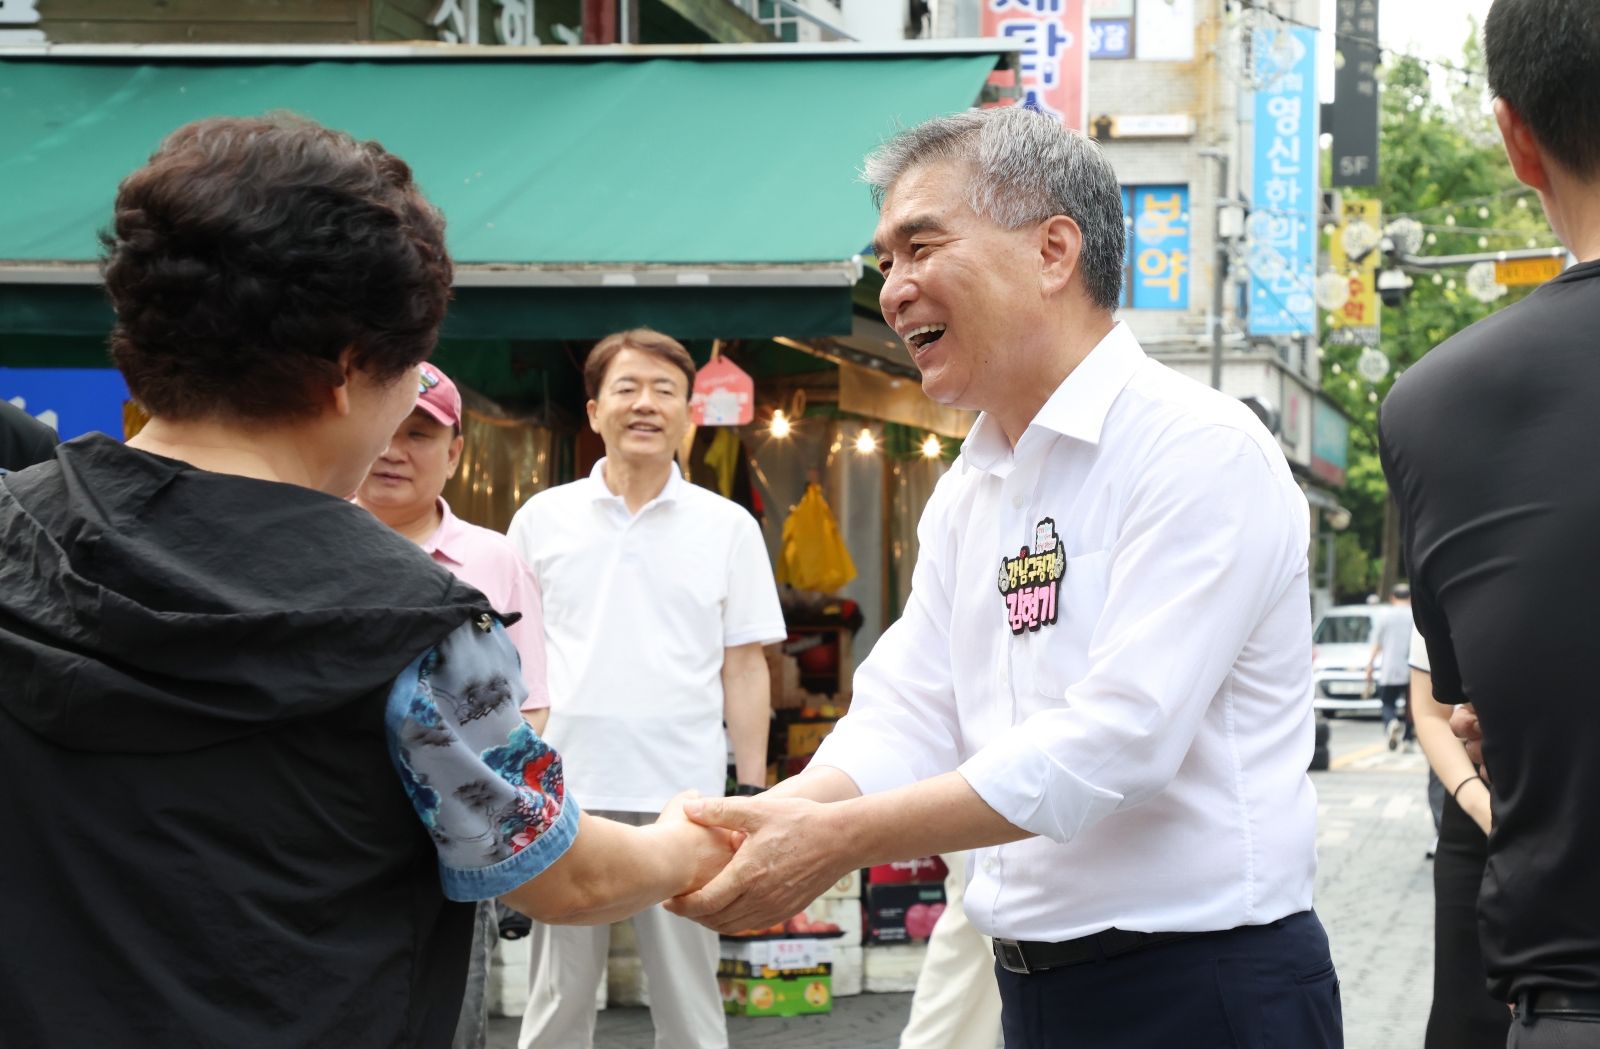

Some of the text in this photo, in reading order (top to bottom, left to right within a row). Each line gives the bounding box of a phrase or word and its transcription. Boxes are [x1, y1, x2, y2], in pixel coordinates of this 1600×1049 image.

[1138, 193, 1188, 301] 보약
[1007, 552, 1057, 588] 강남구청장
[1006, 581, 1057, 631] 김현기
